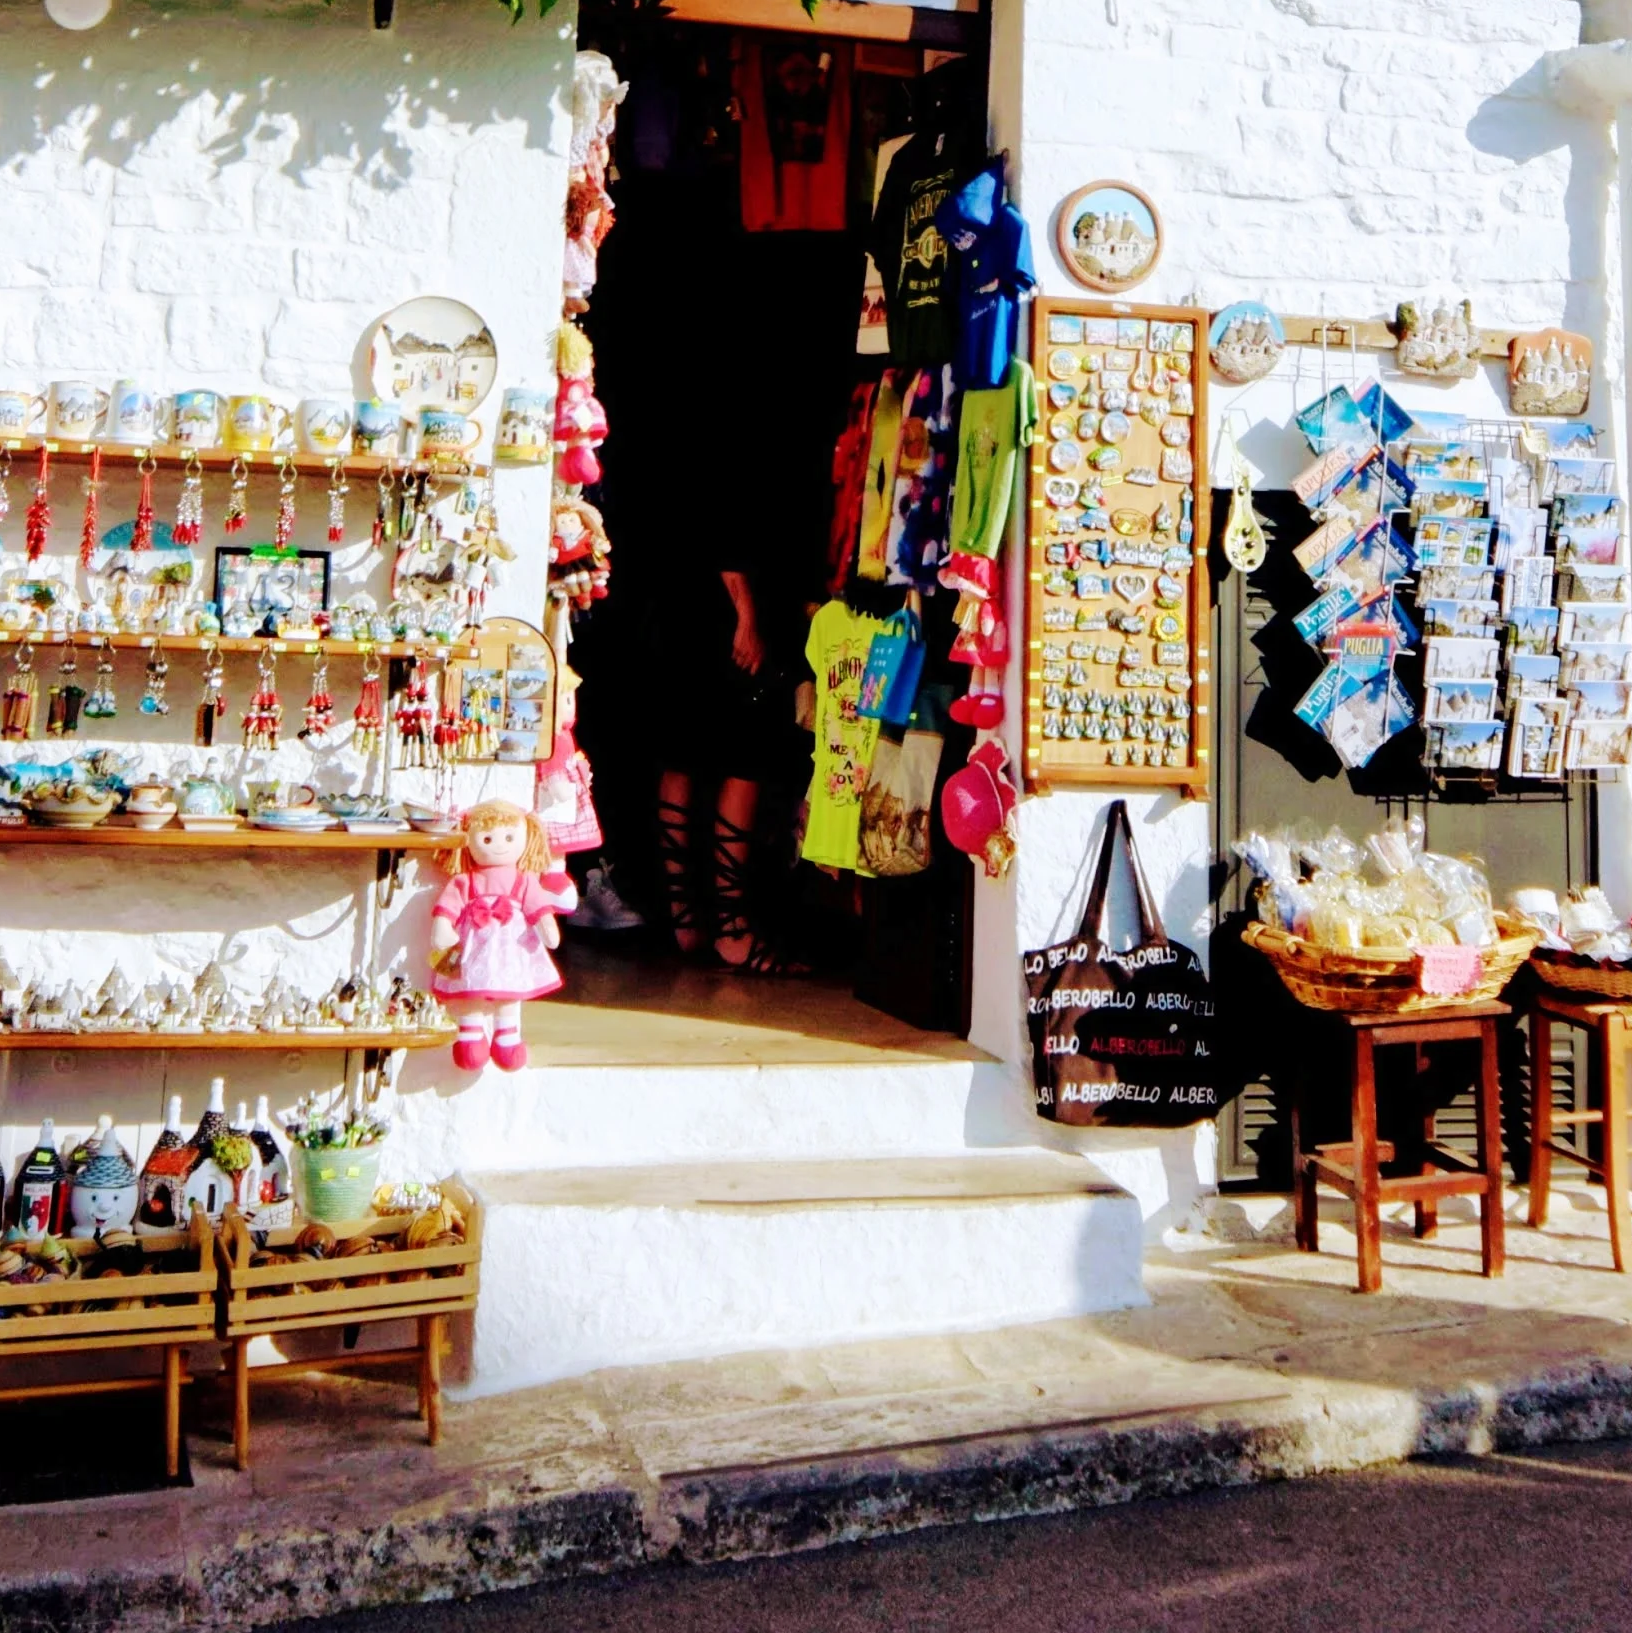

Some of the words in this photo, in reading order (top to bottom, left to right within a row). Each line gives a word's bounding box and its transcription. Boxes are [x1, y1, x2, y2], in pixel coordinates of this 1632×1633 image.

[1298, 589, 1348, 633] Pouille
[1343, 637, 1384, 655] PUGLIA
[1300, 673, 1340, 718] Puglia
[1060, 1081, 1161, 1104] ALBEROBELLO
[1169, 1085, 1217, 1105] ALBER
